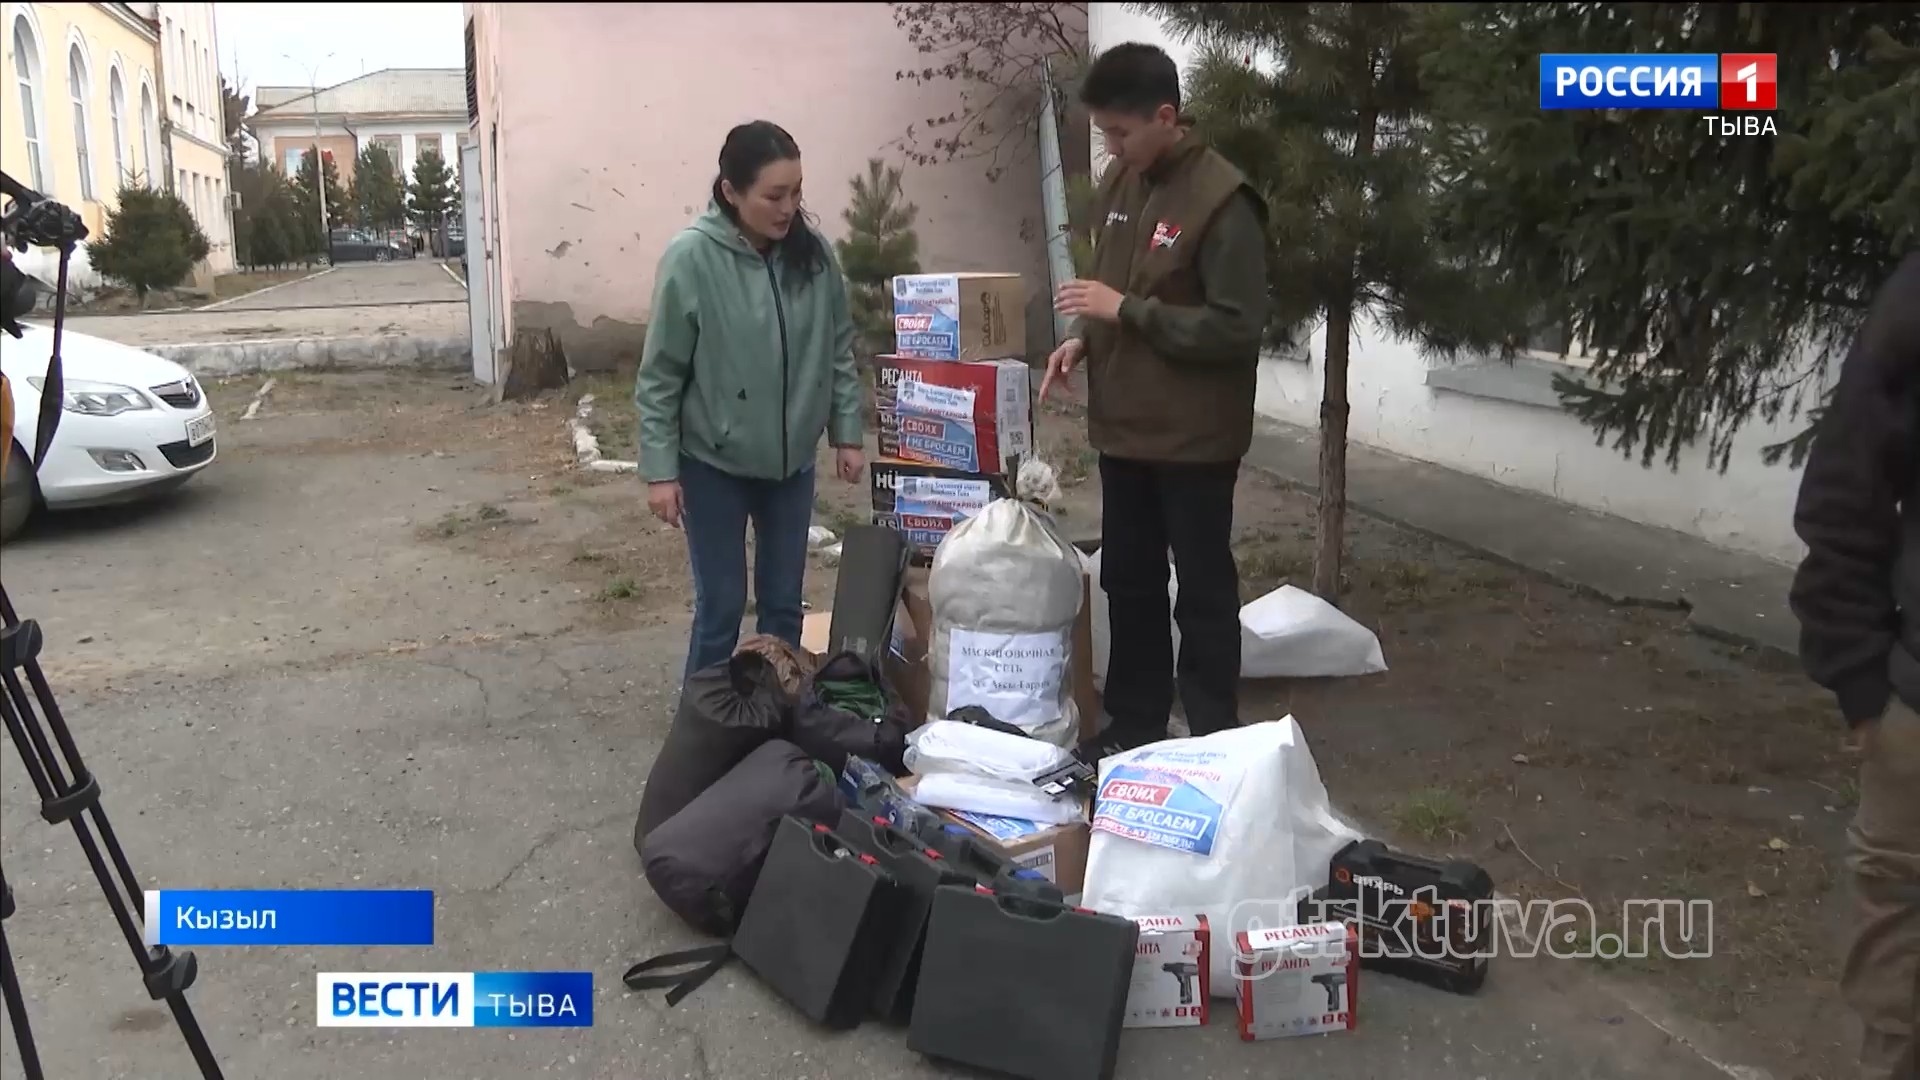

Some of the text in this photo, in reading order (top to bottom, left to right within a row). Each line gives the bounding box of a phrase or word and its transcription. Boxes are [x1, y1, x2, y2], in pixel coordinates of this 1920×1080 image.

[898, 316, 928, 331] СВОИХ
[881, 368, 923, 384] РЕСАНТА
[906, 420, 937, 436] СВОИХ
[911, 437, 923, 449] НЕ
[923, 440, 967, 457] БРОСАЕМ
[906, 516, 945, 529] СВОИХ
[914, 531, 926, 543] НЕ
[1107, 784, 1159, 802] СВОИХ
[1105, 803, 1198, 832] НЕ БРОСАЕМ
[1140, 917, 1182, 926] САНТА
[1264, 926, 1330, 941] РЕСАНТА
[1262, 958, 1311, 972] РЕСАНТА
